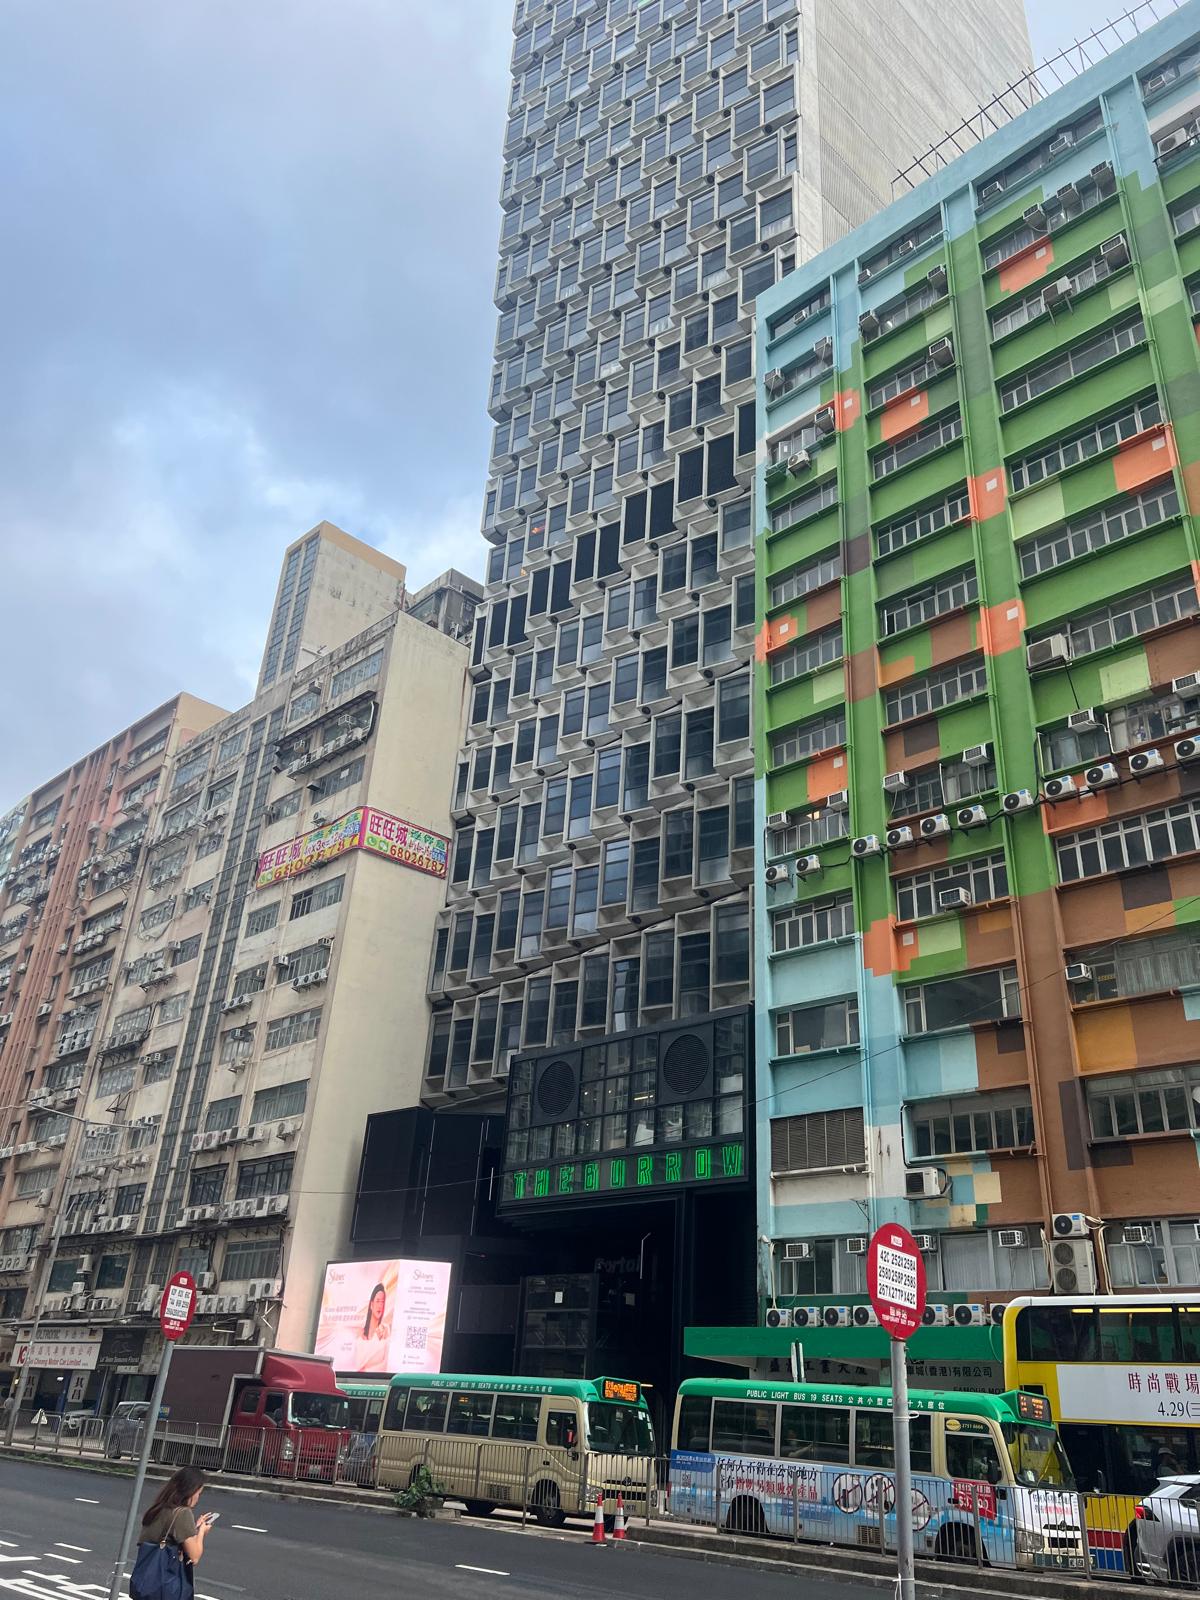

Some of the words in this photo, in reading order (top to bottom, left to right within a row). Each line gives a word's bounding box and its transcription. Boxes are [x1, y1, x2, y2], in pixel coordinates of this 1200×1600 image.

[369, 814, 408, 847] 旺旺城
[390, 844, 444, 874] 68028787
[513, 1165, 575, 1200] THE
[584, 1143, 744, 1191] BURROW
[746, 1389, 767, 1399] PUBLIC
[771, 1391, 789, 1400] LIGHT
[793, 1392, 806, 1401] BUS
[810, 1394, 817, 1402] 19
[821, 1395, 843, 1404] SEATS
[1128, 1372, 1200, 1395] 時尚戰場
